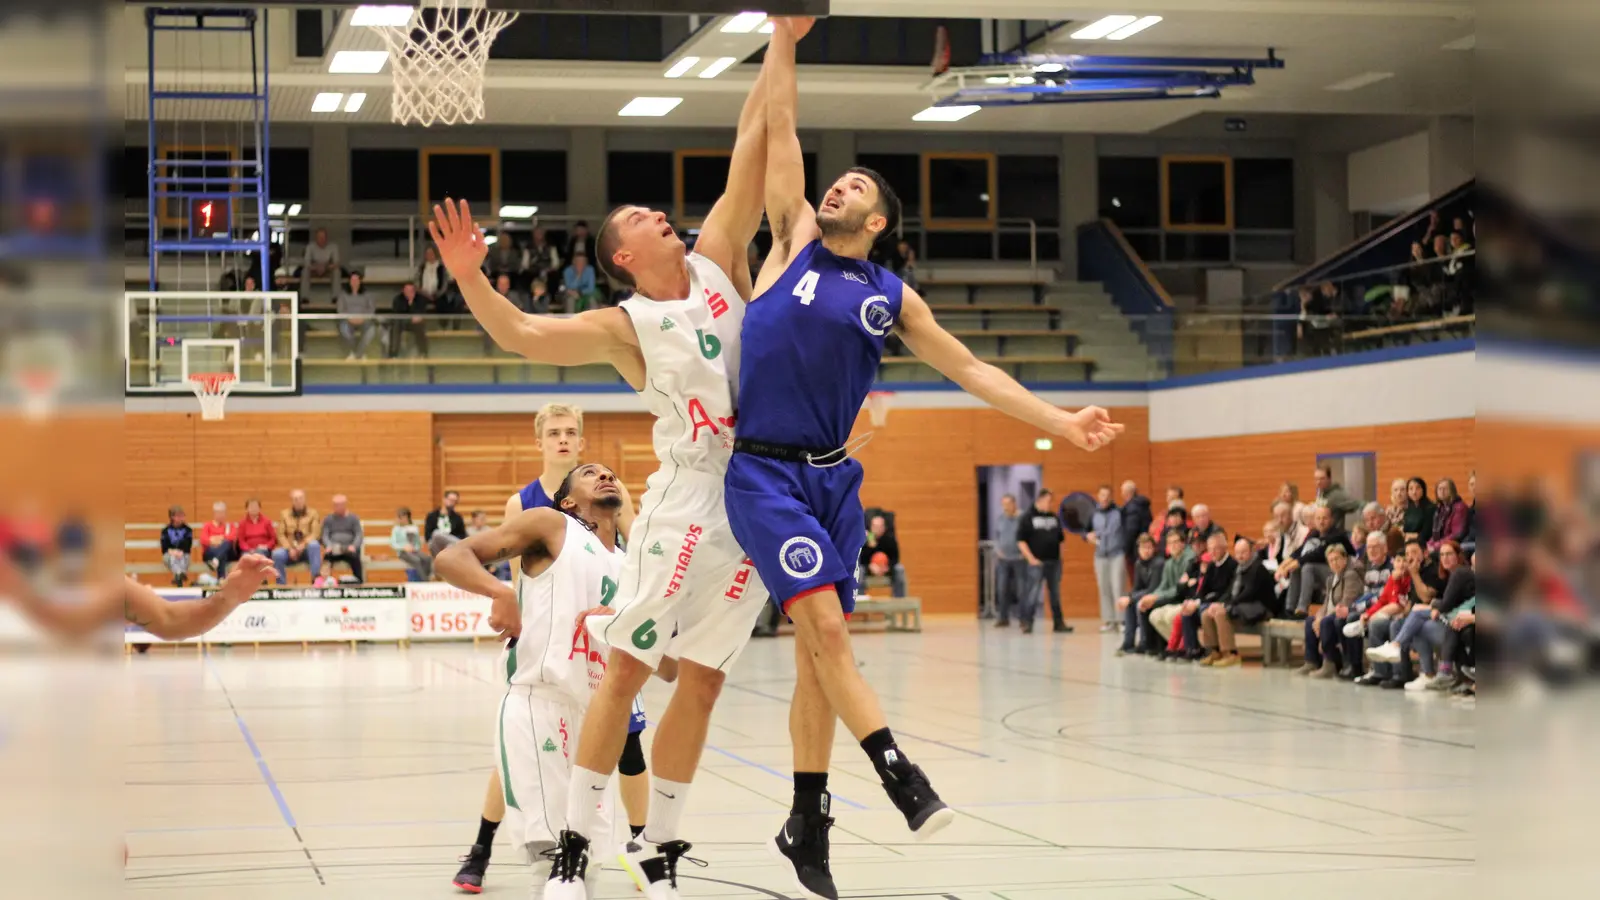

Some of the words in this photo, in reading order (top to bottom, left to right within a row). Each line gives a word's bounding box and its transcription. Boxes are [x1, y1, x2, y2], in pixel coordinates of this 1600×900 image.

[792, 270, 820, 305] 4
[411, 613, 482, 632] 91567
[631, 618, 657, 650] 6
